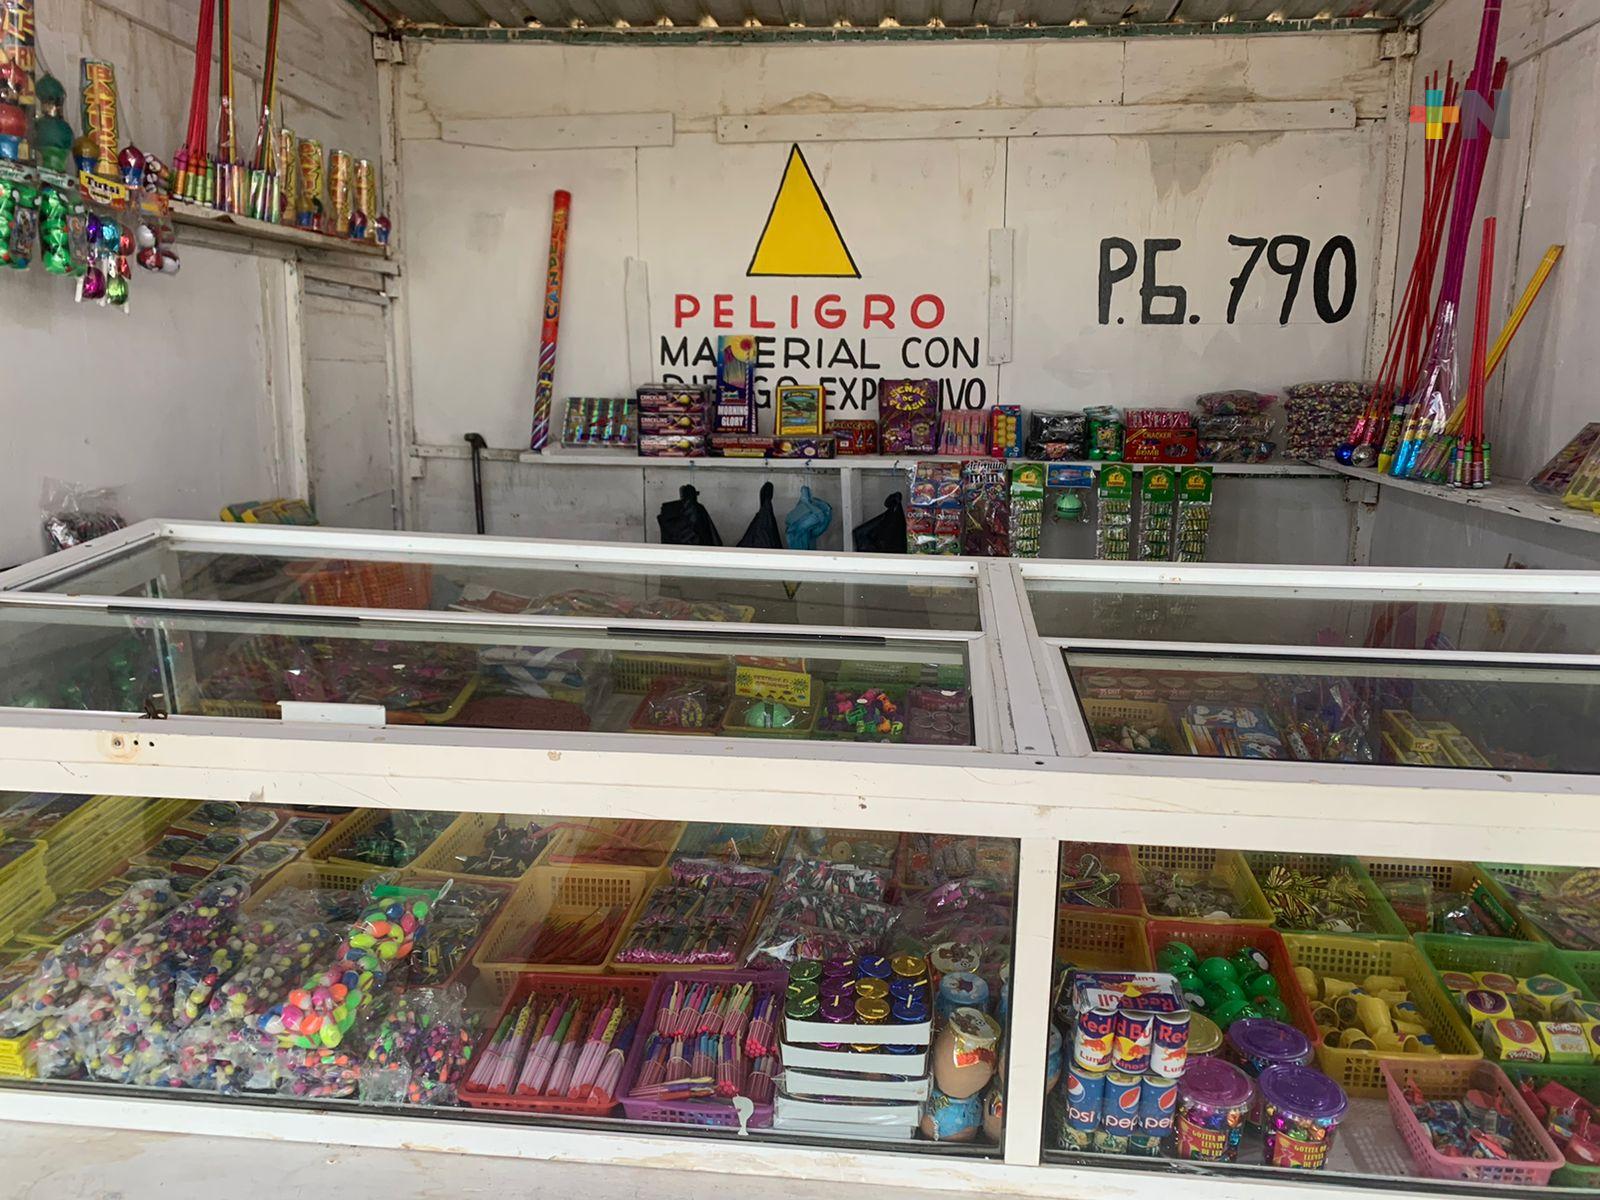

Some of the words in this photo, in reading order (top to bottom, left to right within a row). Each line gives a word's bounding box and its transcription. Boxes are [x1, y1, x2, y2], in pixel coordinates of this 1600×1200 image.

[85, 175, 120, 194] Tutsi
[1228, 235, 1357, 325] 790
[674, 294, 946, 330] PELIGRO
[661, 335, 881, 369] MAERIAL
[902, 337, 980, 369] CON
[718, 405, 748, 415] MORNING
[819, 377, 986, 412] EXPIVO
[722, 416, 744, 426] GLORY
